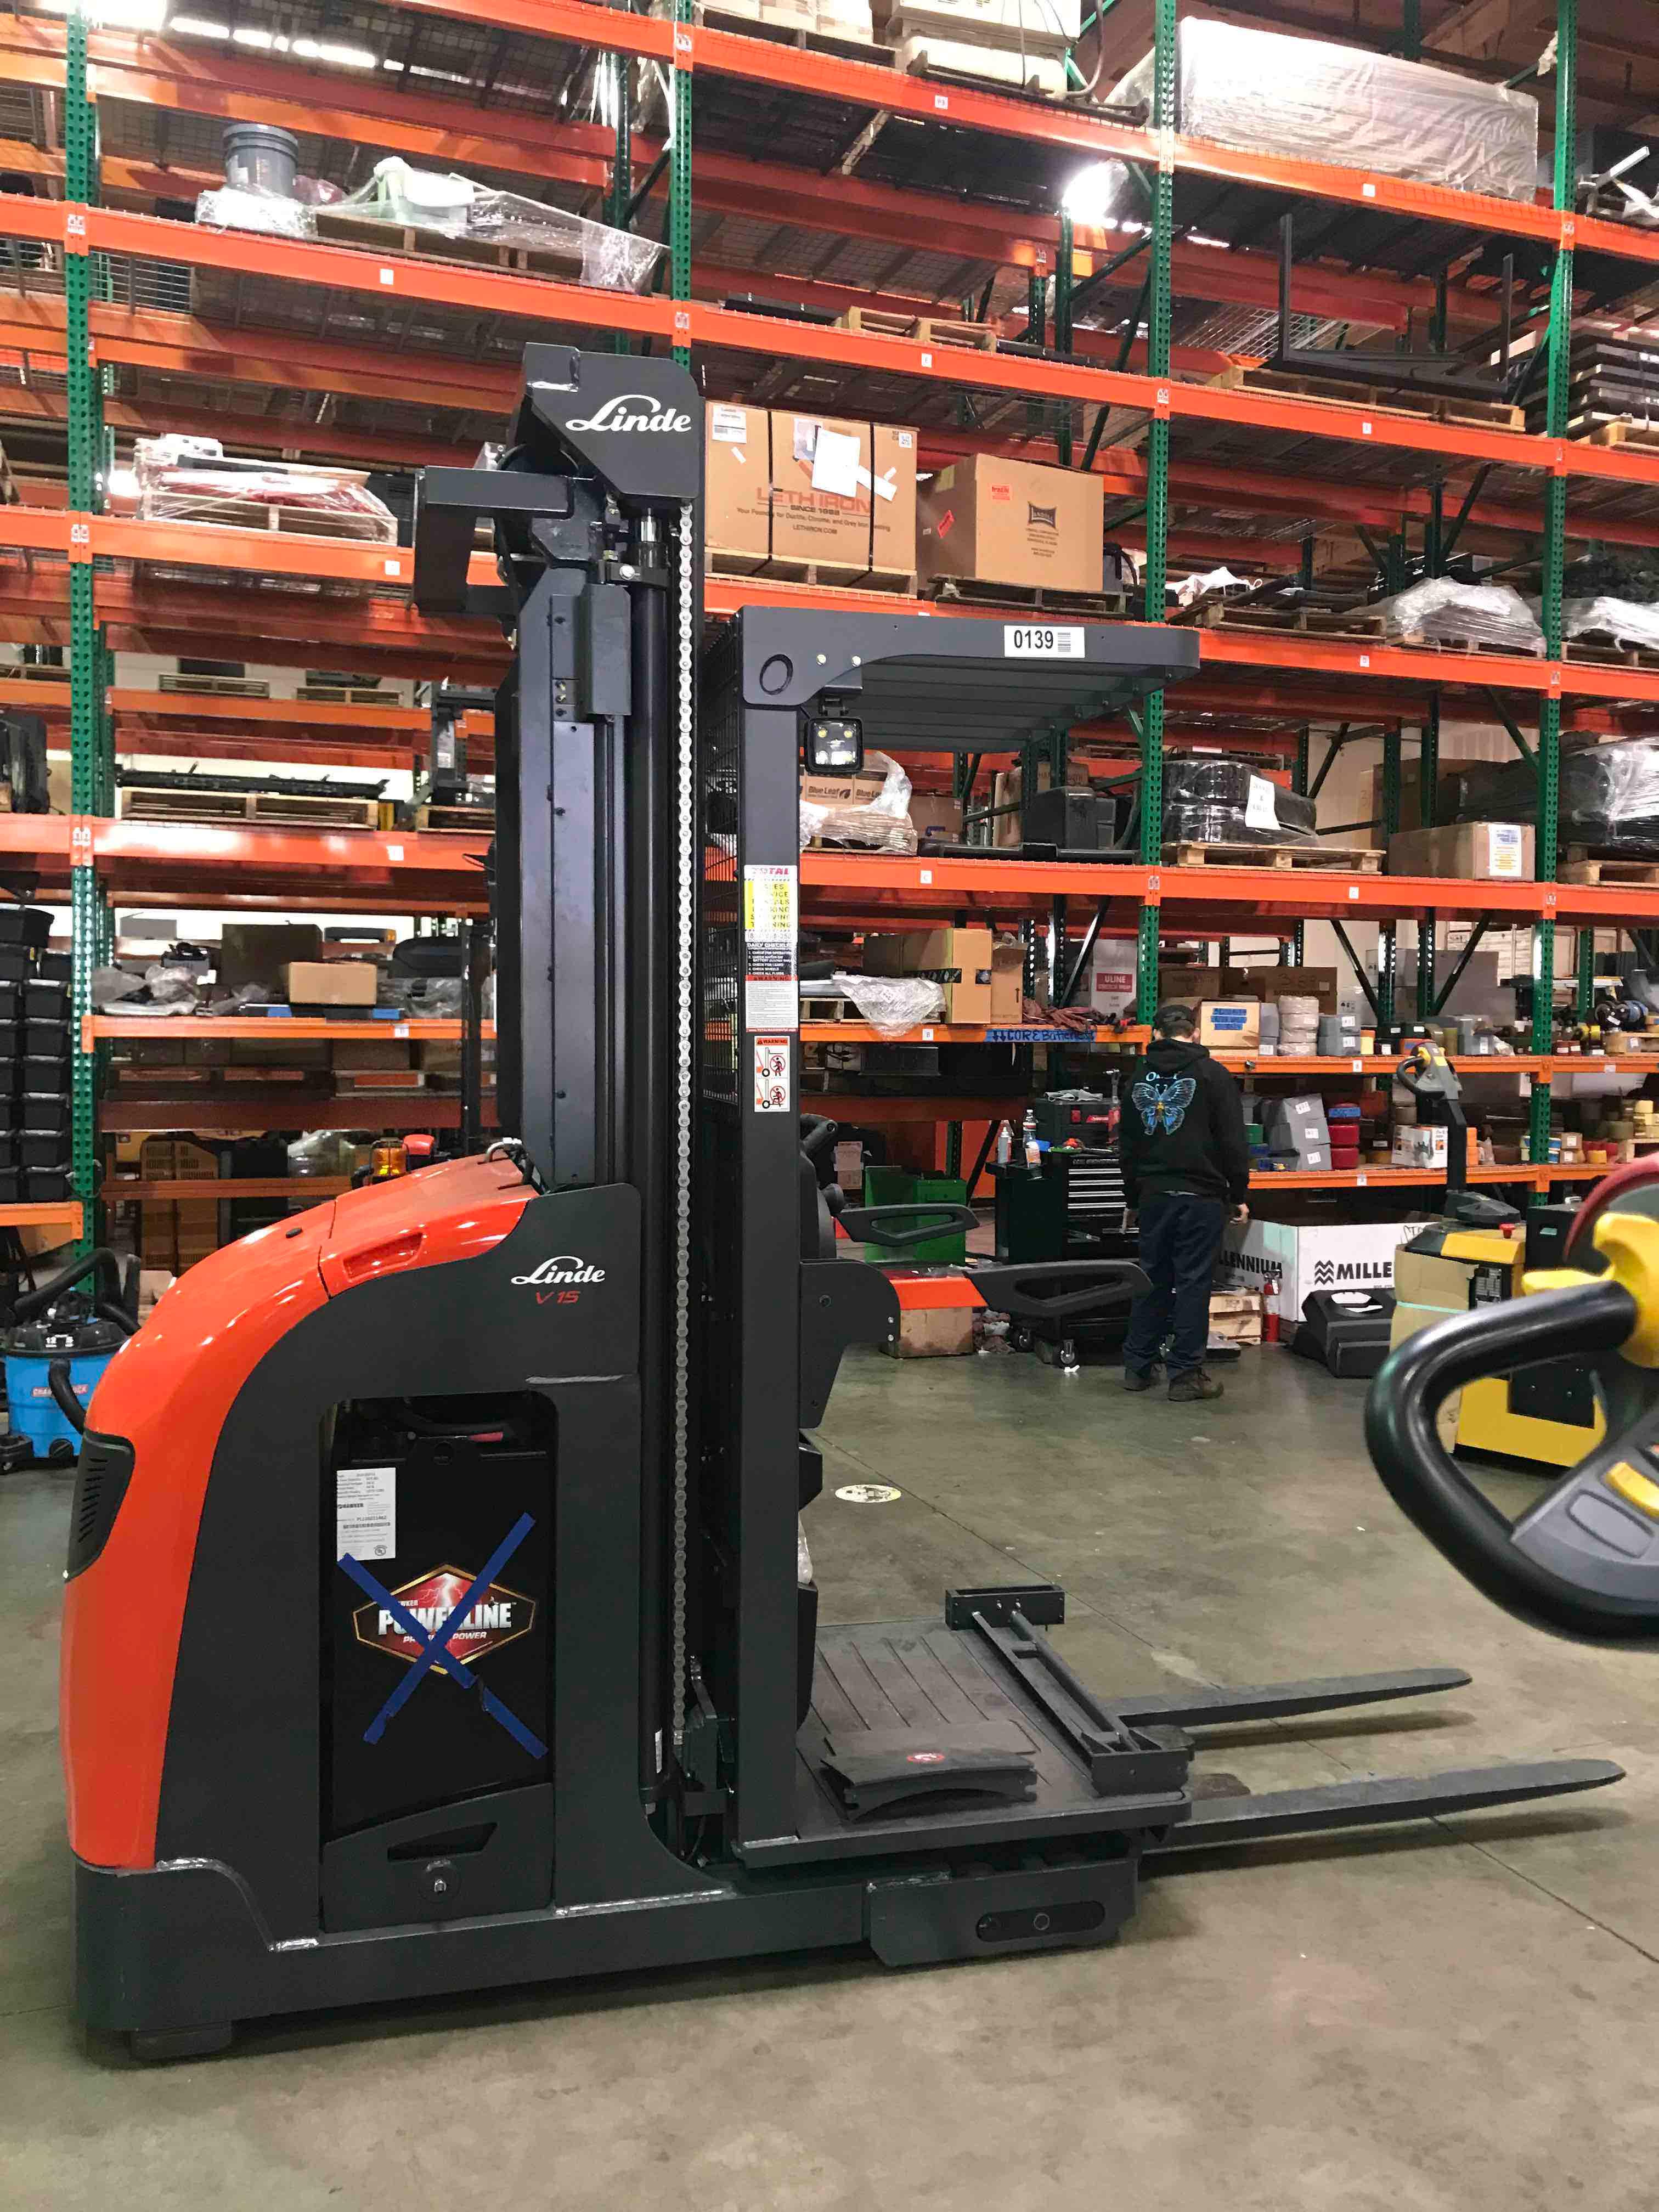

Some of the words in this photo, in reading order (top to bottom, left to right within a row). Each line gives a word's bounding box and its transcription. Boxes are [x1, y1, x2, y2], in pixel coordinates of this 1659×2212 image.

[566, 394, 691, 432] Linde
[1014, 630, 1054, 649] 0139
[808, 786, 823, 794] Blue
[824, 787, 840, 795] Leaf
[1104, 975, 1126, 984] ULINE
[511, 1256, 606, 1284] Linde
[1336, 1262, 1392, 1280] MILLE
[452, 1632, 487, 1640] POWER
